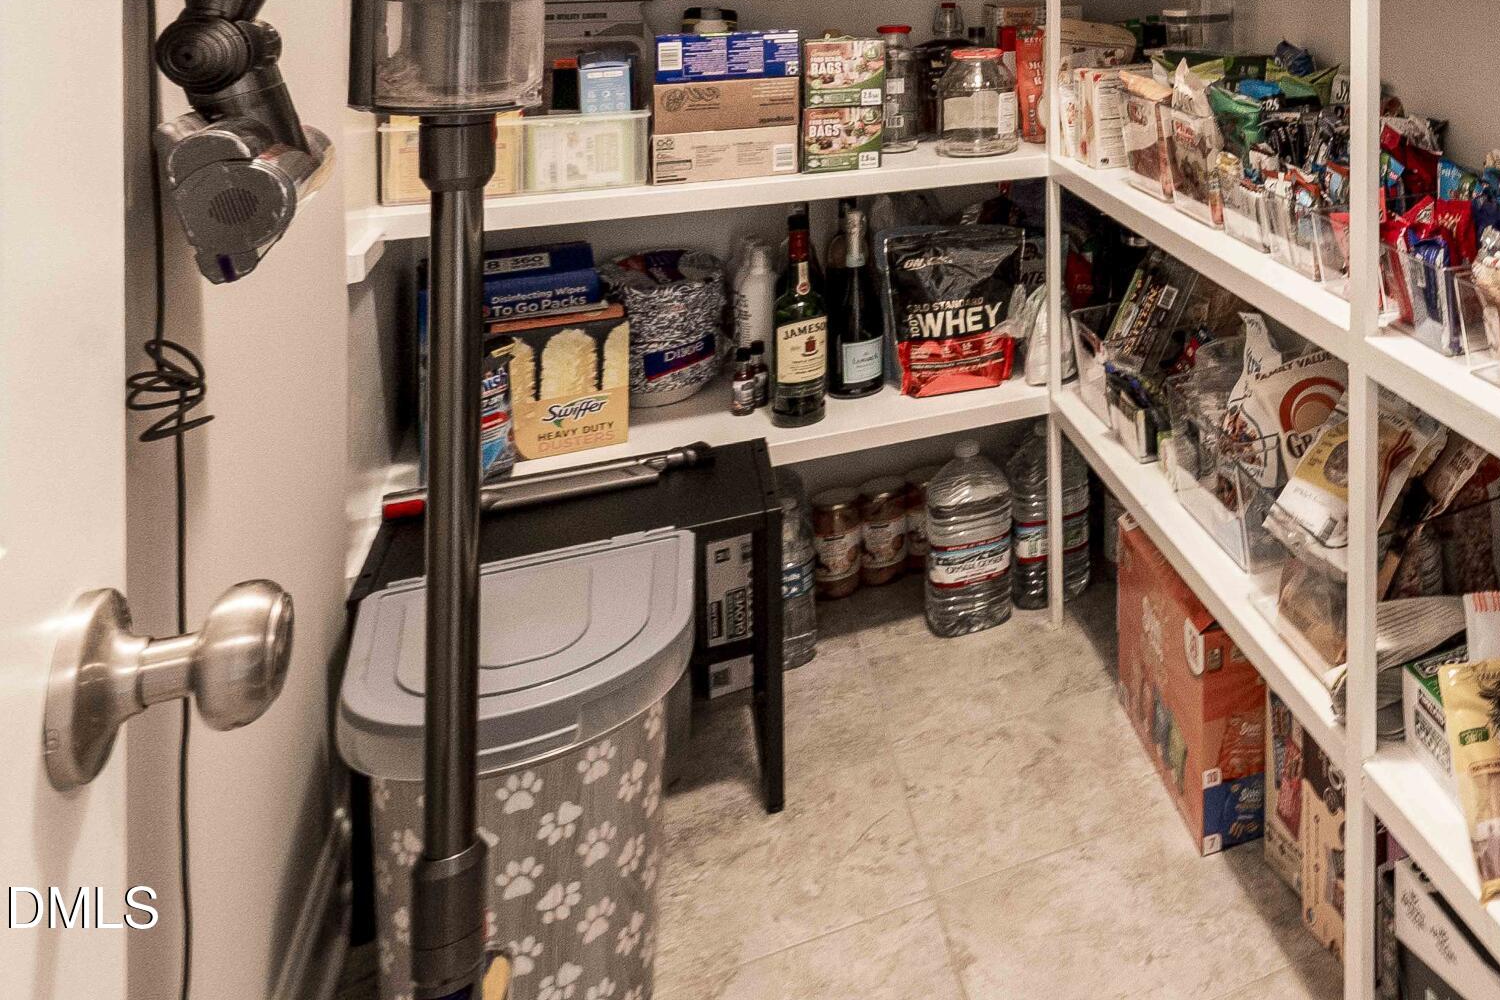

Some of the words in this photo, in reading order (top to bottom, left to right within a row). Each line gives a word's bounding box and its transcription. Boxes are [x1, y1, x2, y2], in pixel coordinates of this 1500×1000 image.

[810, 62, 842, 75] BAGS
[808, 124, 841, 137] BAGS
[487, 260, 500, 270] 8
[511, 254, 543, 265] 360
[555, 286, 588, 296] Wipes
[492, 306, 513, 317] To
[514, 302, 538, 314] Go
[540, 295, 588, 311] Packs
[916, 302, 1004, 338] WHEY
[783, 322, 827, 341] JAMESO
[542, 399, 608, 421] Swiffer
[537, 427, 578, 442] HEAVY
[582, 421, 615, 434] DUTY
[537, 430, 616, 452] DUSTERS
[735, 590, 747, 636] GLOVES
